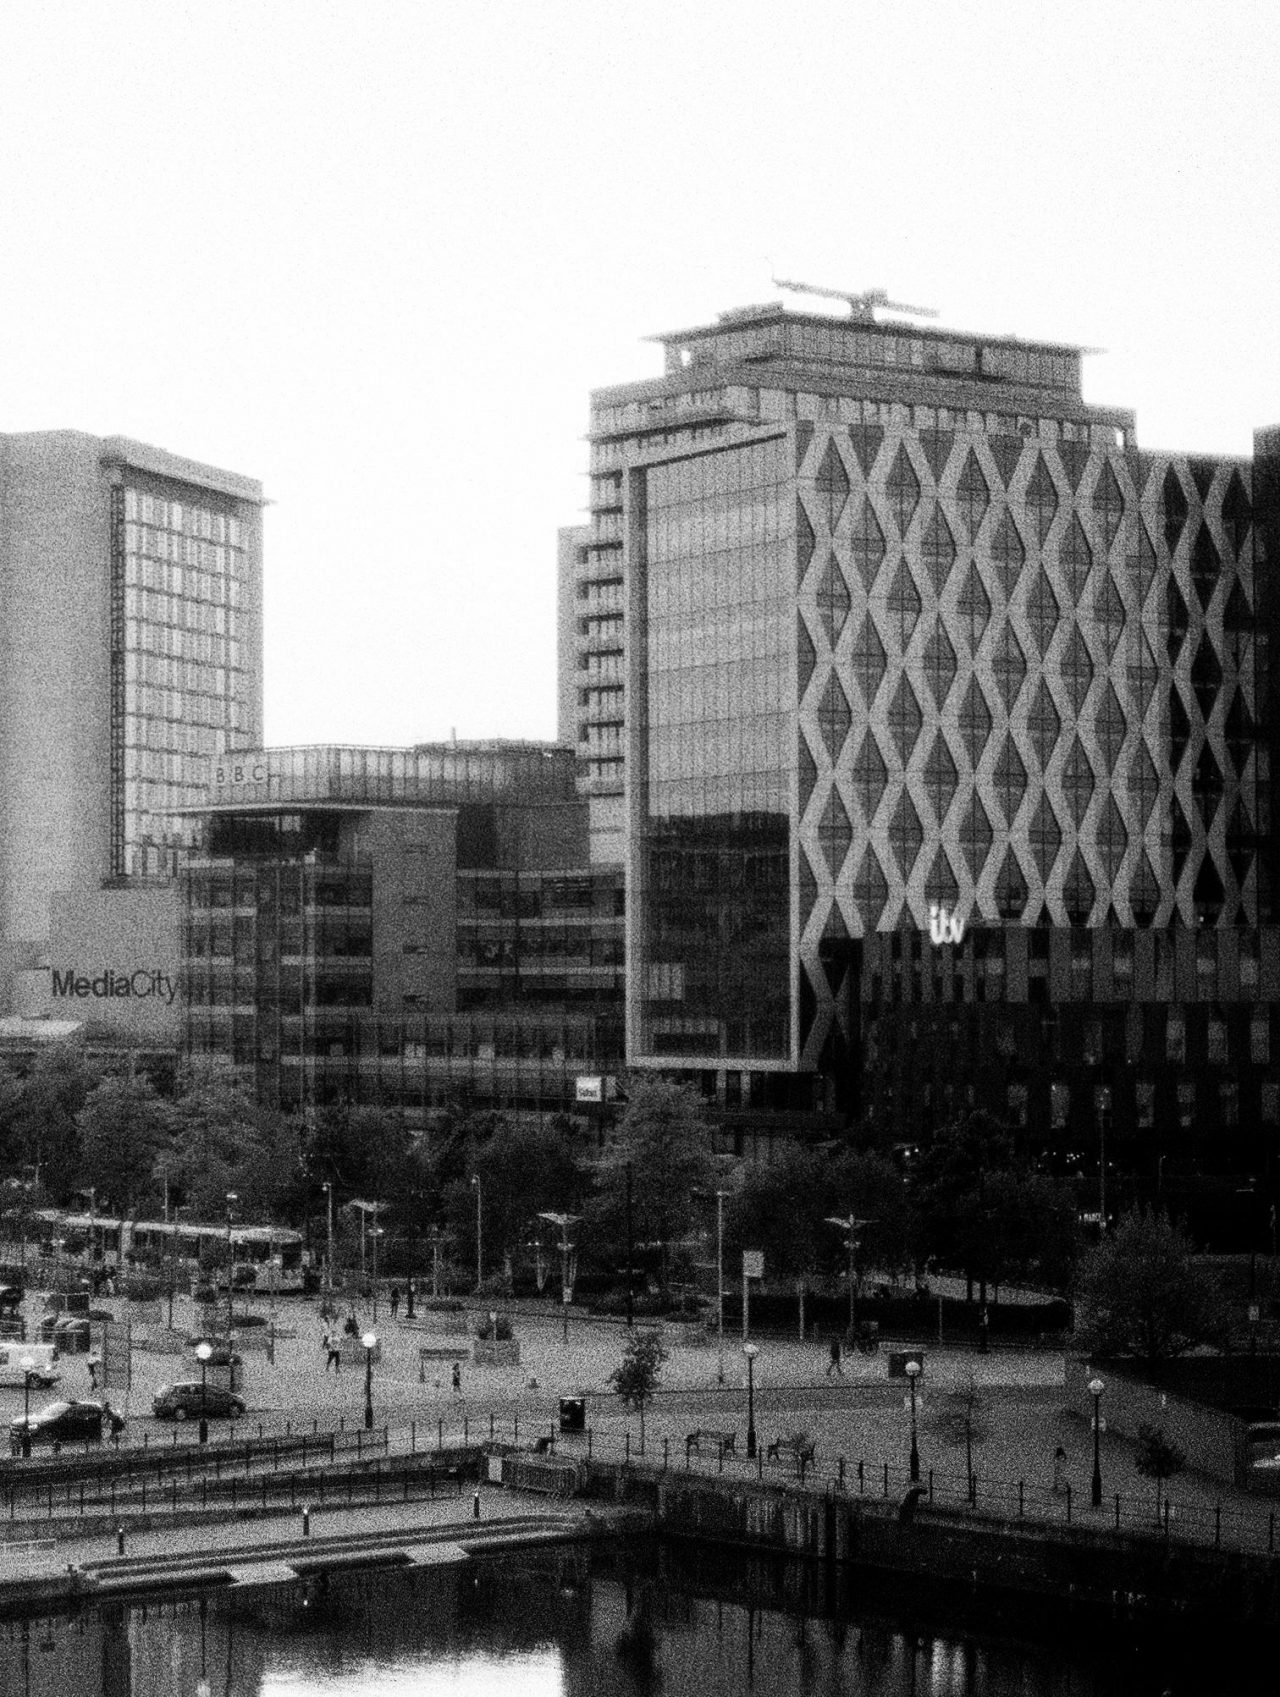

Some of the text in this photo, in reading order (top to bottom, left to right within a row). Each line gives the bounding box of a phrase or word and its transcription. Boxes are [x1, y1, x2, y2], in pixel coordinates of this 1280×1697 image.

[216, 764, 264, 784] BBC
[929, 905, 966, 944] itv
[51, 969, 179, 1005] MediaCity
